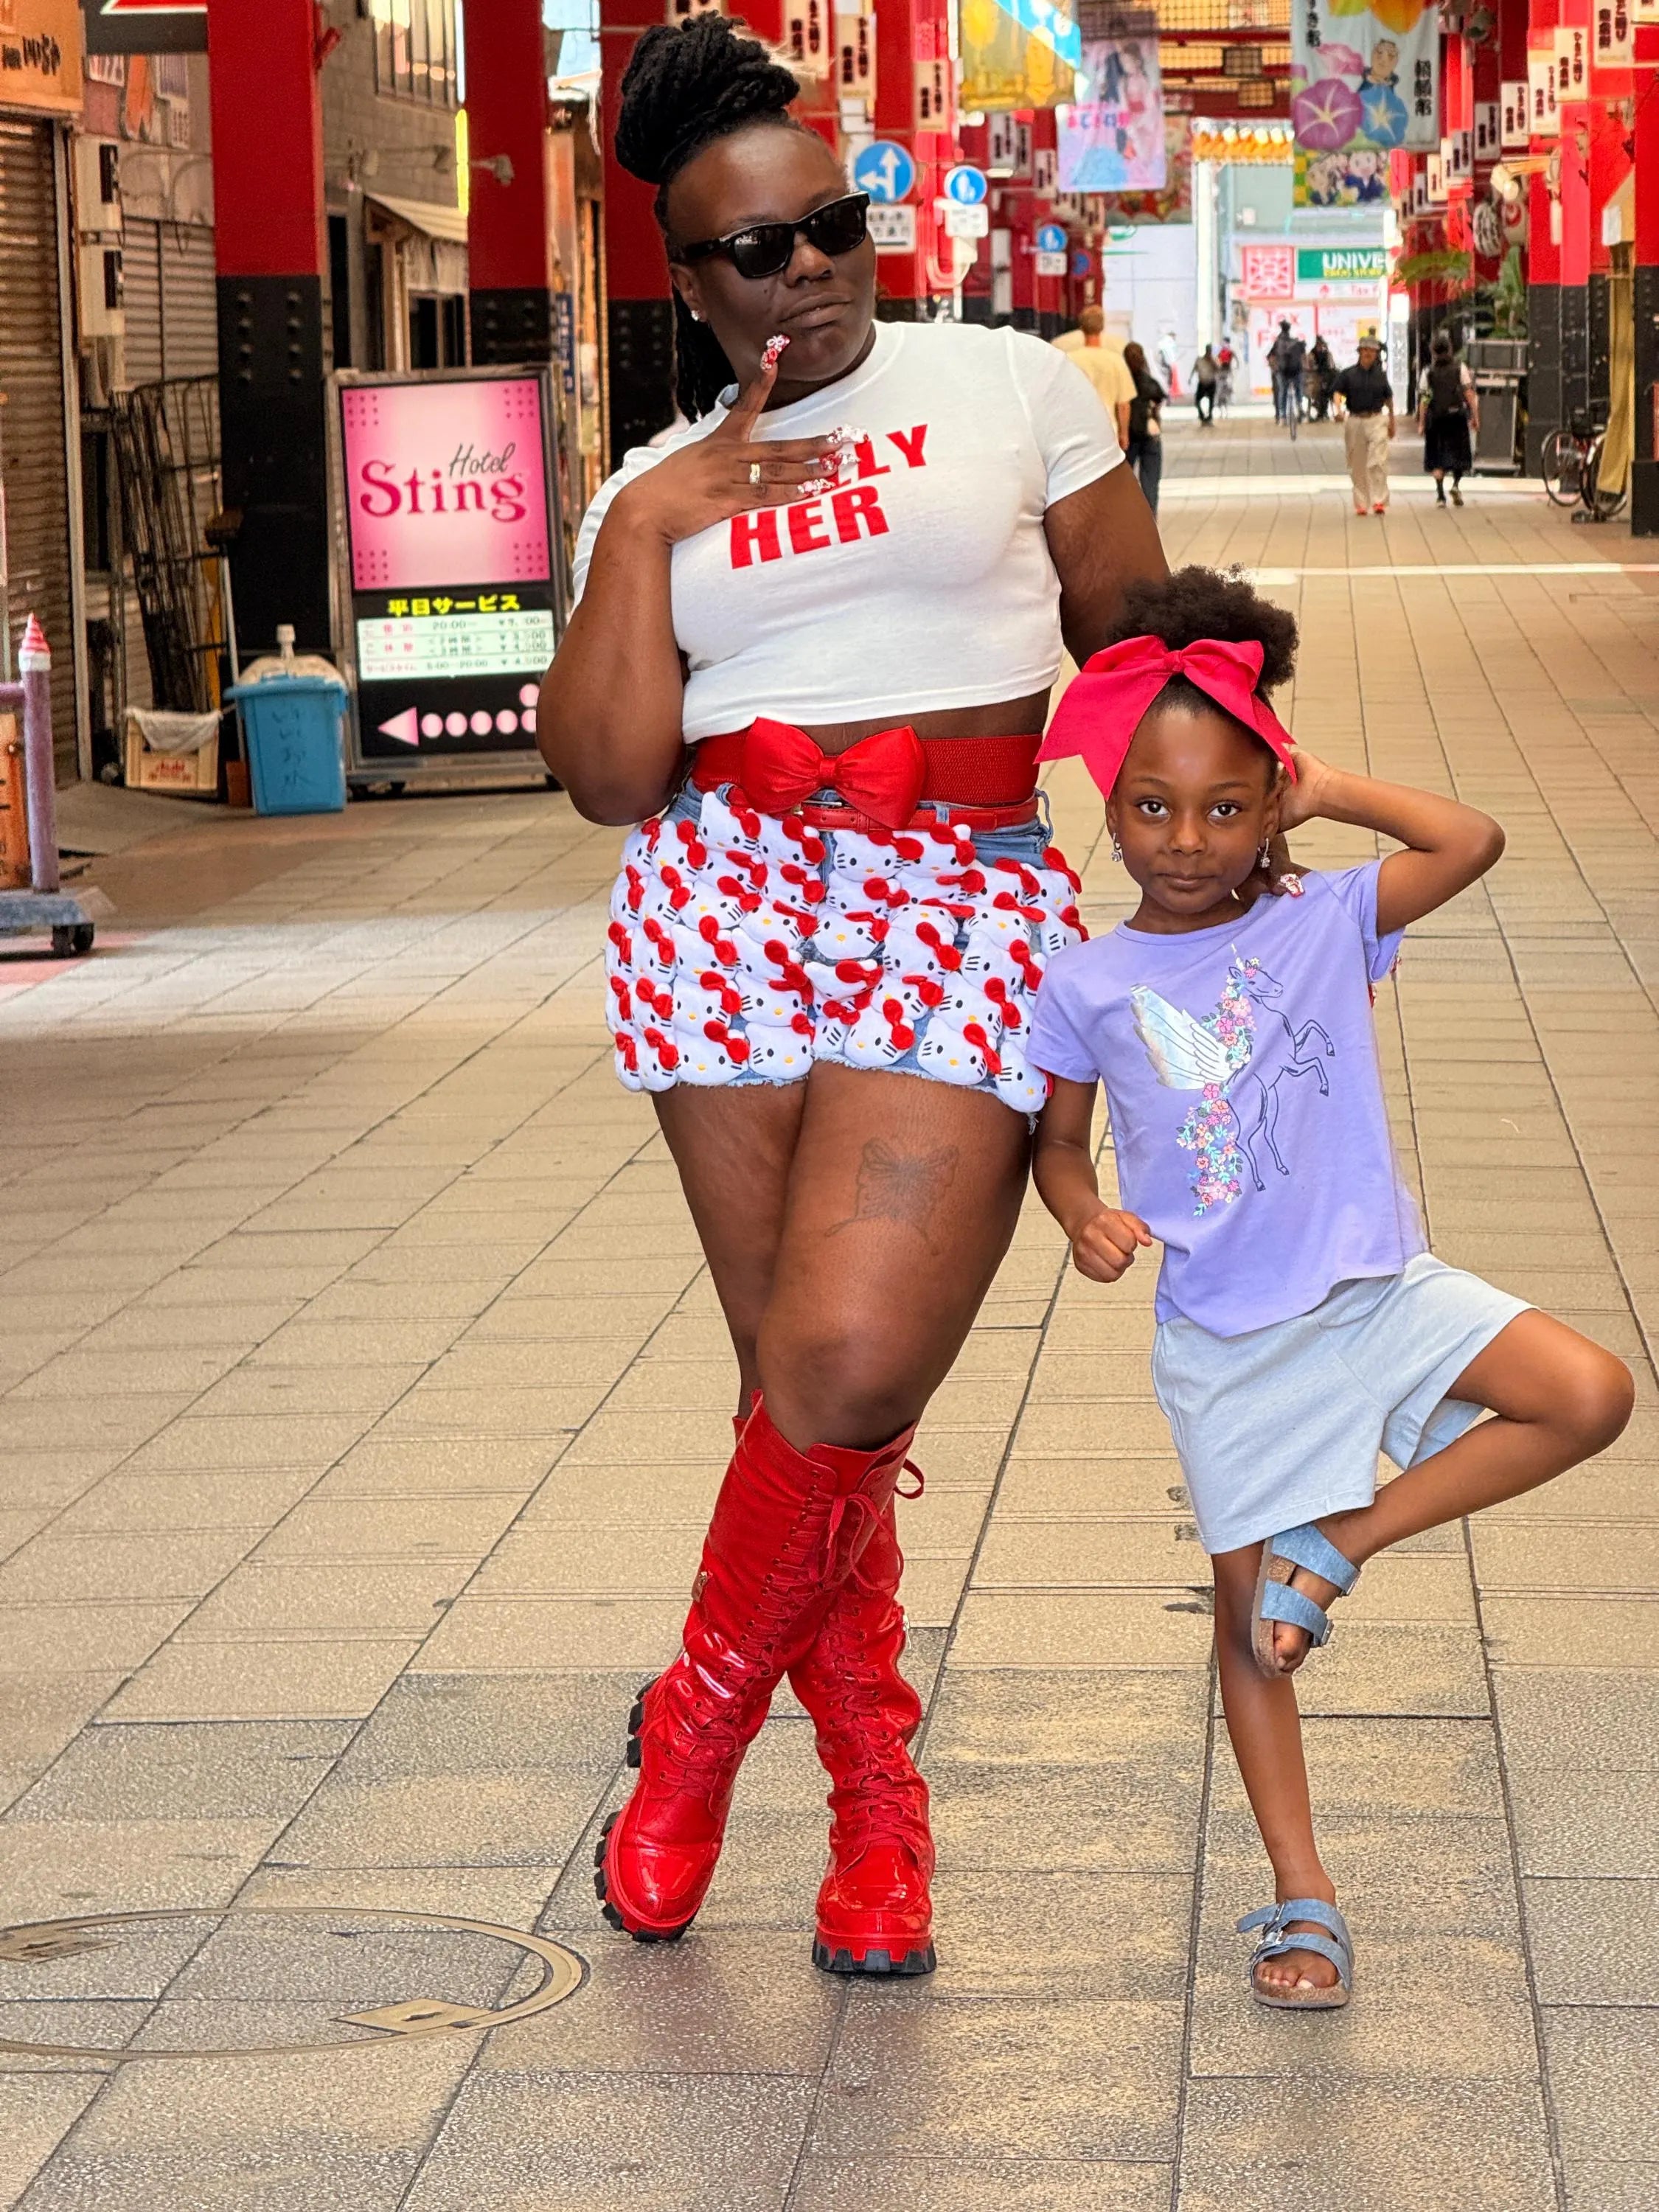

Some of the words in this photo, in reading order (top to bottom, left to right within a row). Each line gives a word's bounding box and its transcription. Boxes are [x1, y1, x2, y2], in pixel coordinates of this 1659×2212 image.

[361, 459, 526, 523] Sting
[449, 442, 516, 478] Hotel
[731, 486, 889, 569] HER
